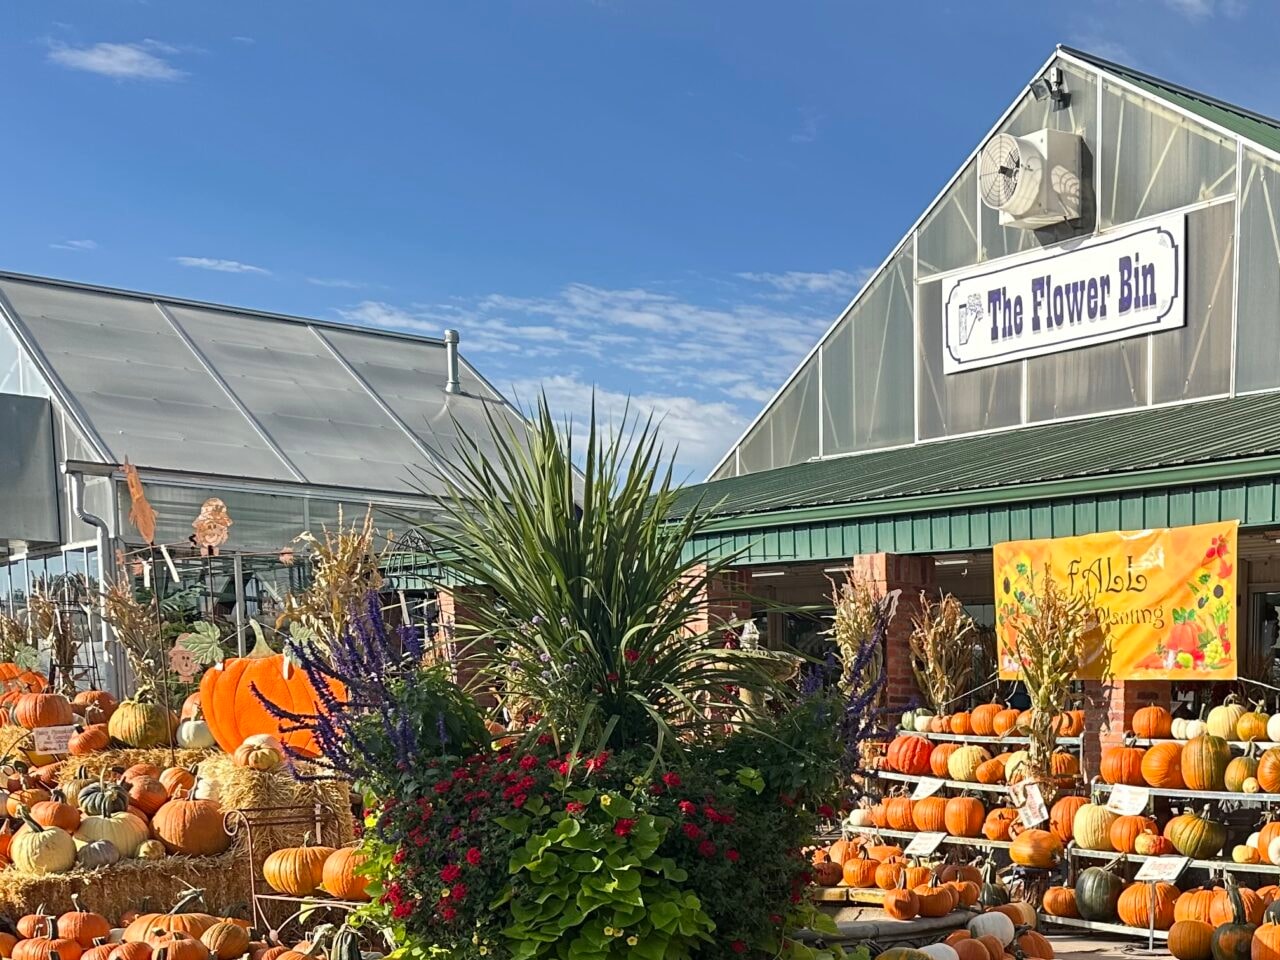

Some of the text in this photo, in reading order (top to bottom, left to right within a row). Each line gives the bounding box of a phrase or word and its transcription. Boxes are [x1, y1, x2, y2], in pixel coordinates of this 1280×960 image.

[987, 252, 1158, 342] The Flower Bin
